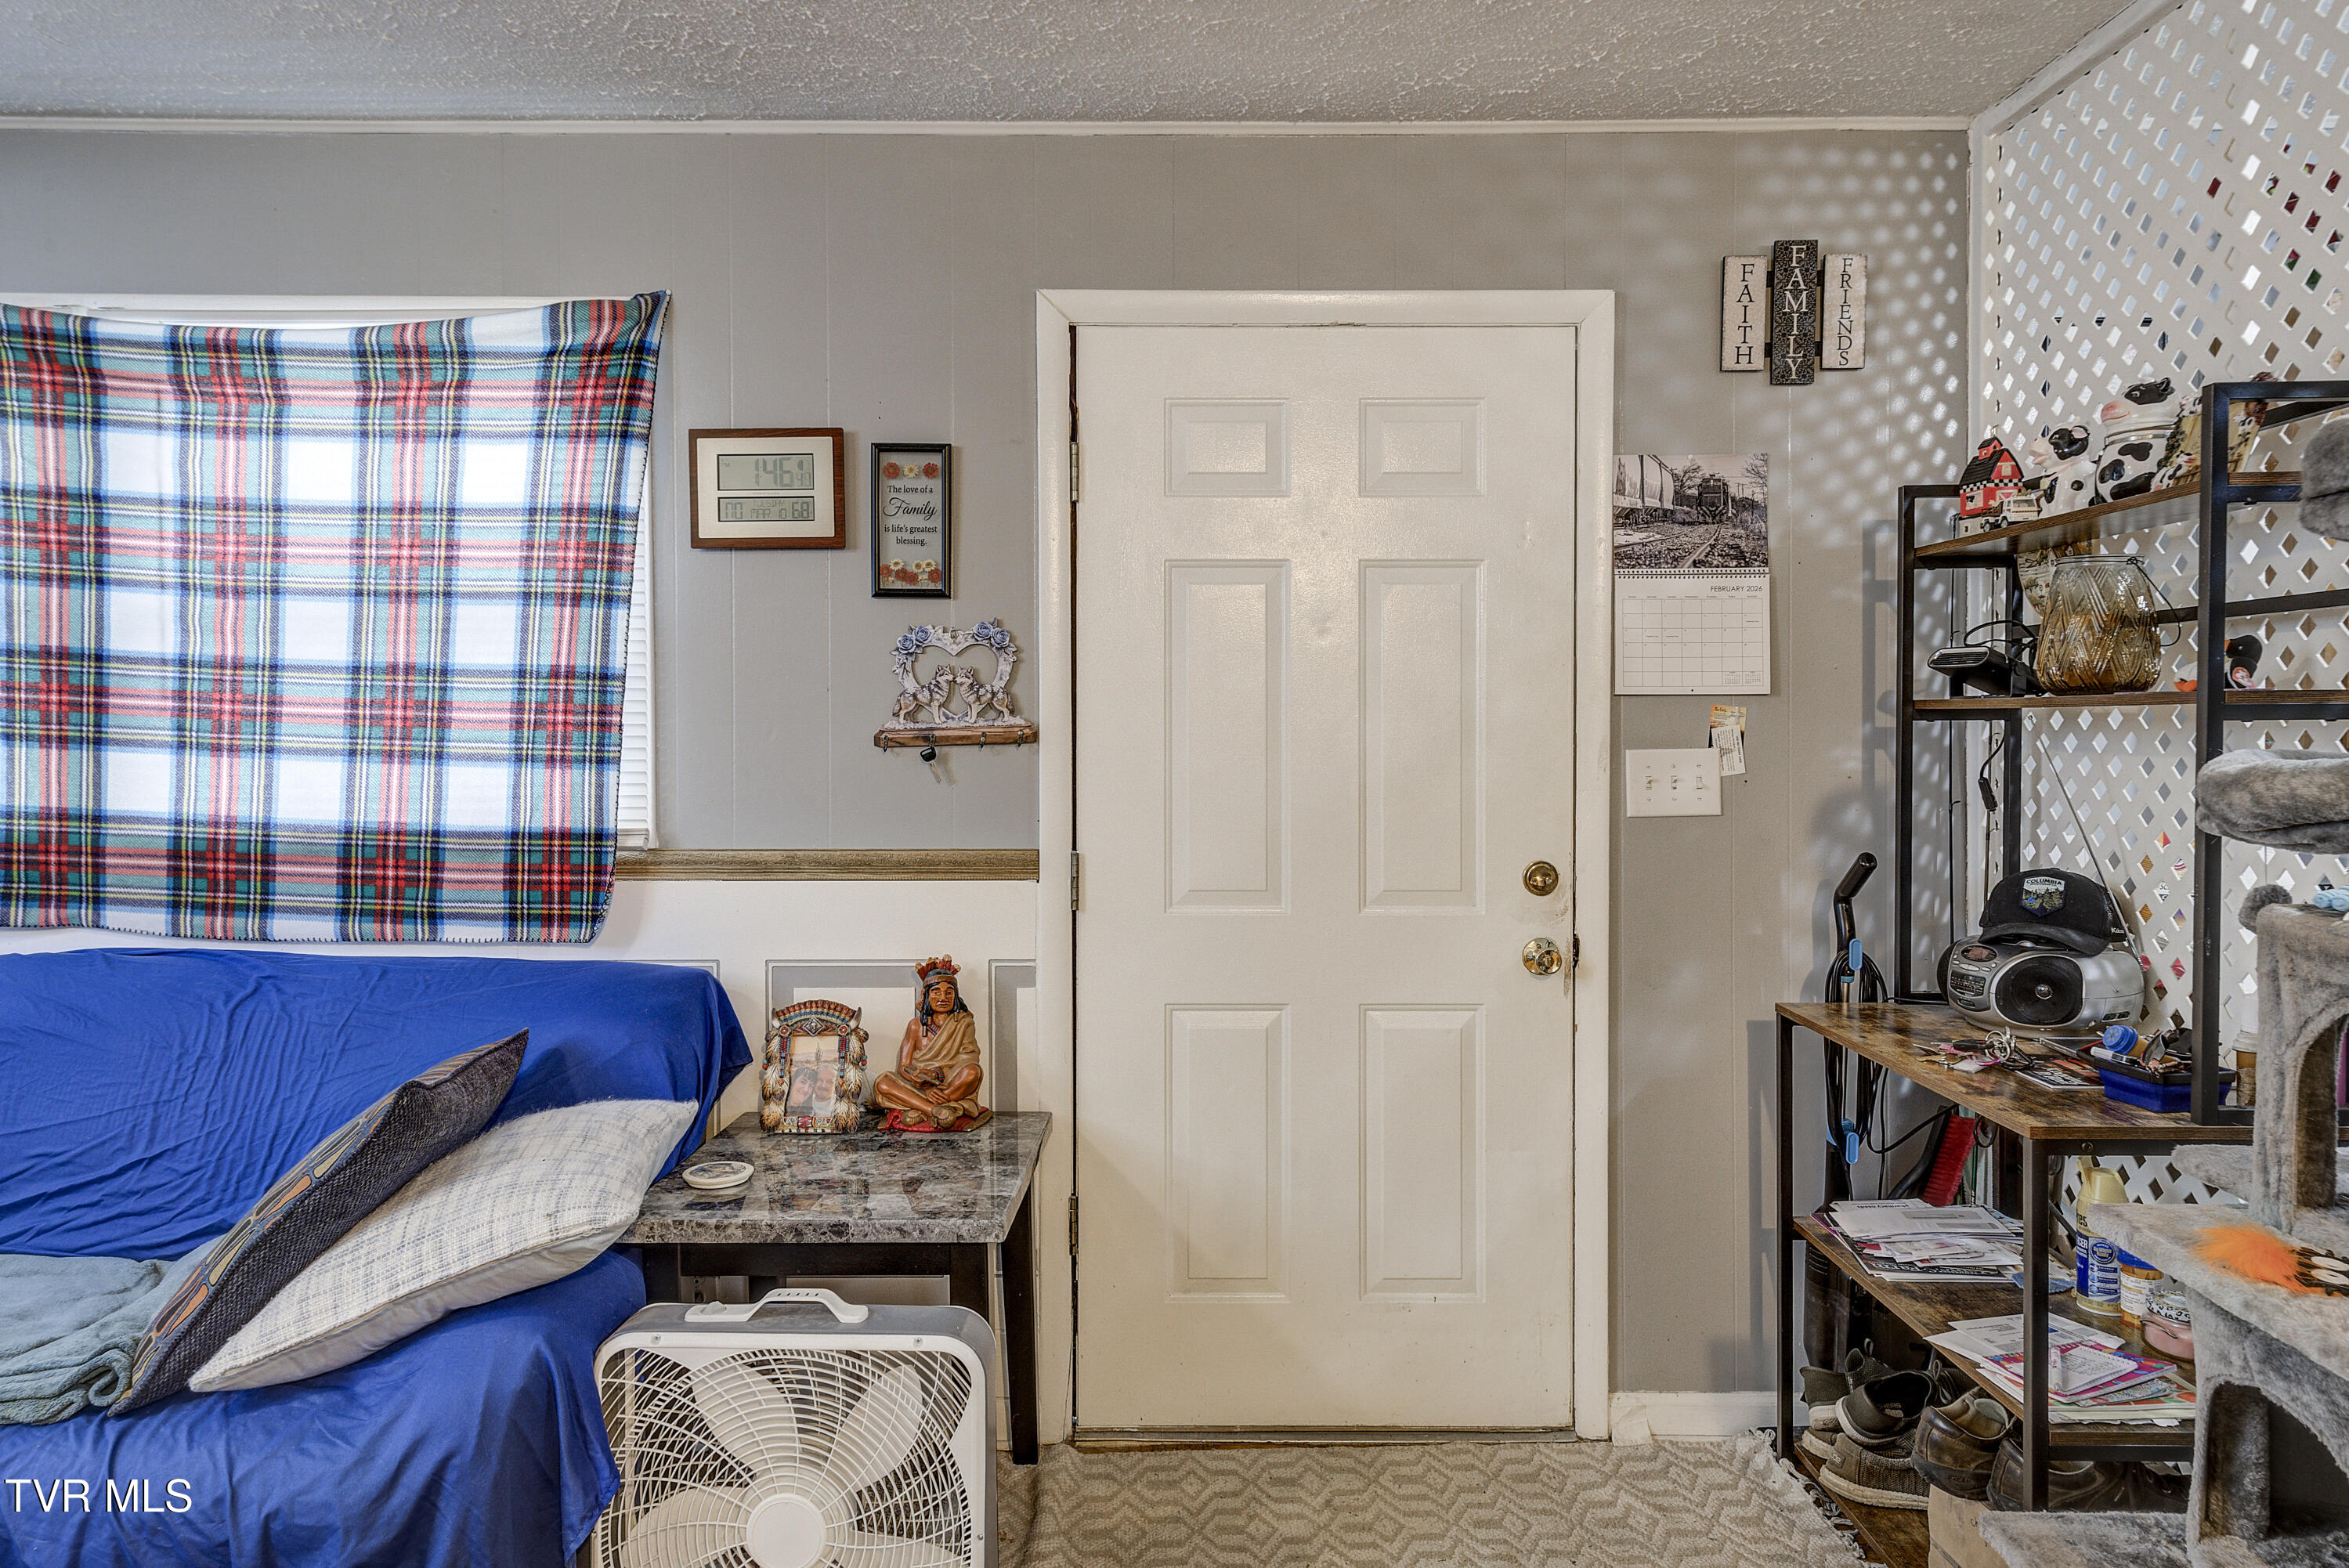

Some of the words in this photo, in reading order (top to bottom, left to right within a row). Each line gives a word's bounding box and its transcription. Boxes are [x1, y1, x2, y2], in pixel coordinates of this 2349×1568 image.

[1734, 263, 1755, 365] FAITH
[1783, 245, 1809, 379] FAMILY
[1836, 258, 1854, 366] FRIENDS
[887, 485, 902, 493] The
[903, 485, 919, 493] love
[920, 485, 928, 493] of
[883, 497, 938, 521] Family
[884, 524, 891, 533] is
[891, 523, 909, 533] life's
[909, 526, 938, 535] greatest
[896, 536, 927, 546] blessing.
